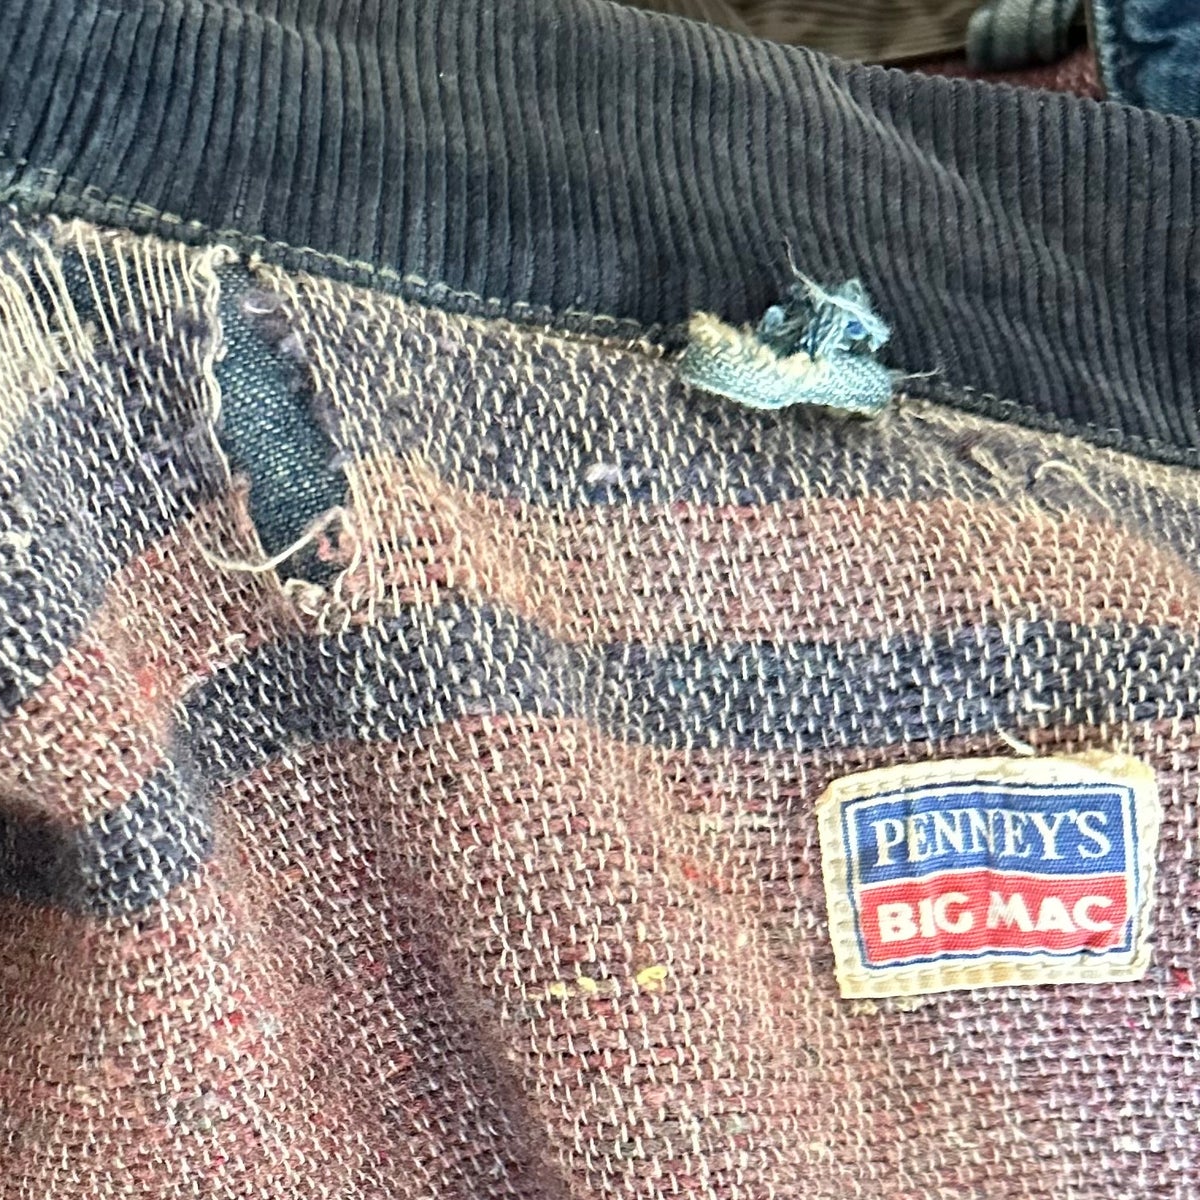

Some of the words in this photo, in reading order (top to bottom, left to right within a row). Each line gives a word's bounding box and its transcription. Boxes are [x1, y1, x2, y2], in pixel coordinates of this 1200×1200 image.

[871, 807, 1113, 867] PENNEY'S
[876, 892, 974, 943] BIG
[987, 891, 1114, 933] MAC
